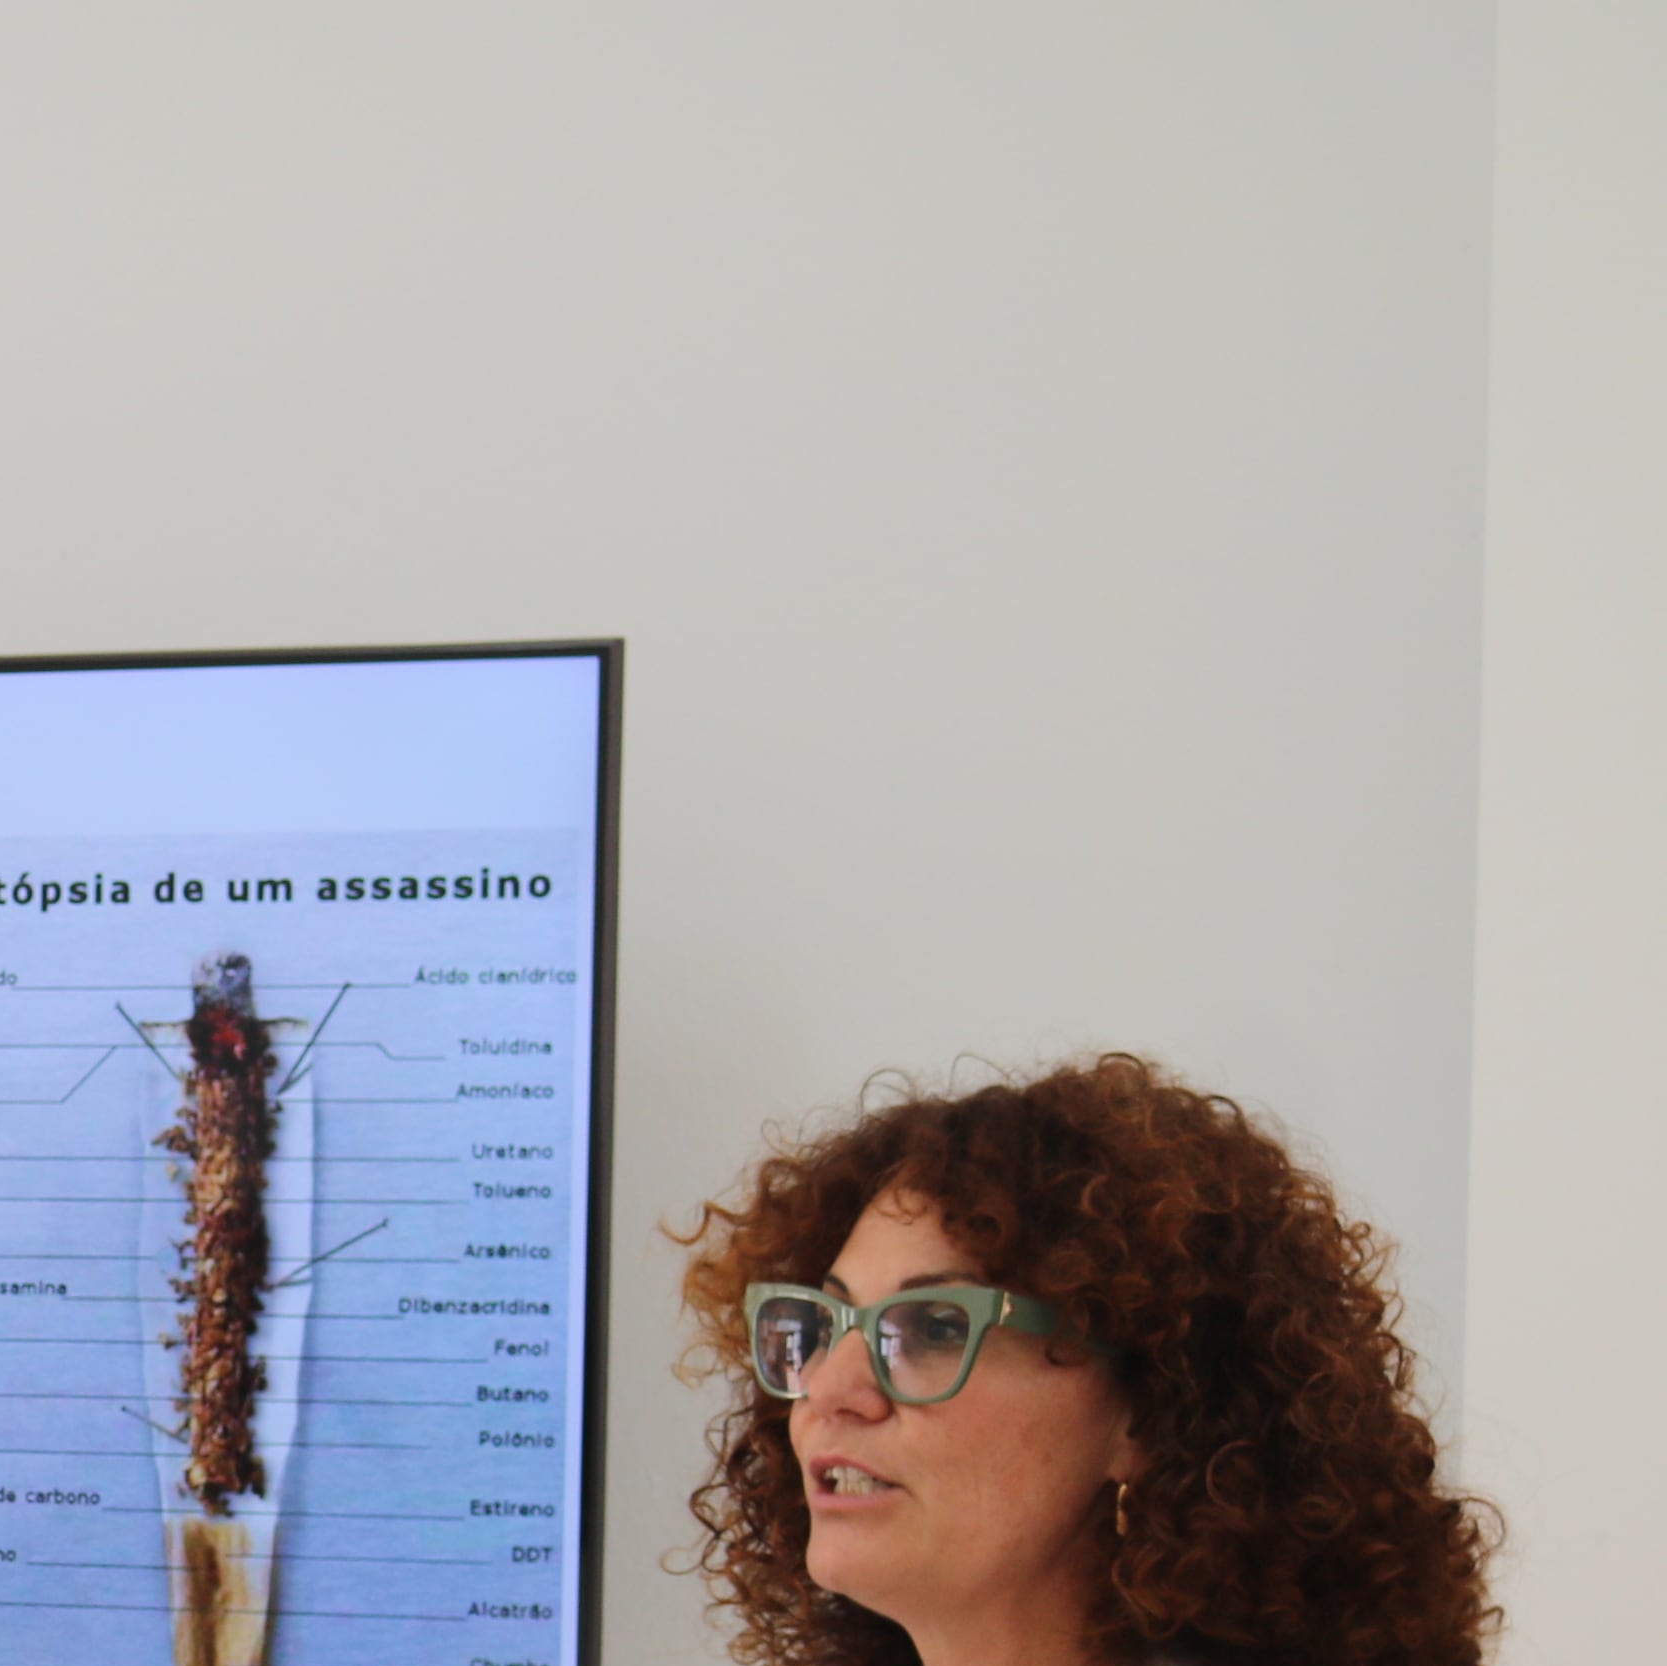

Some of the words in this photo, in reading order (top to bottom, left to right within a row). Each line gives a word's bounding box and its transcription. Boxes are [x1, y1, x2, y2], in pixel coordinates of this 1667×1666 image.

[154, 873, 204, 904] de
[227, 878, 293, 902] um
[317, 867, 551, 901] assassino
[414, 965, 470, 985] Ácido
[459, 1038, 553, 1056] Toluidina
[456, 1082, 555, 1099] Amoníaco
[471, 1144, 554, 1160] Uretano
[472, 1181, 552, 1199] Tolueno
[464, 1243, 552, 1260] Arsênico
[398, 1297, 551, 1316] Dibenzacridina
[494, 1338, 550, 1357] Fenol
[476, 1385, 550, 1403] Butano
[478, 1430, 555, 1449] Polônio
[25, 1488, 101, 1505] carbono
[470, 1499, 556, 1518] Estireno
[511, 1546, 554, 1563] DDT
[468, 1601, 553, 1620] Alcatrão
